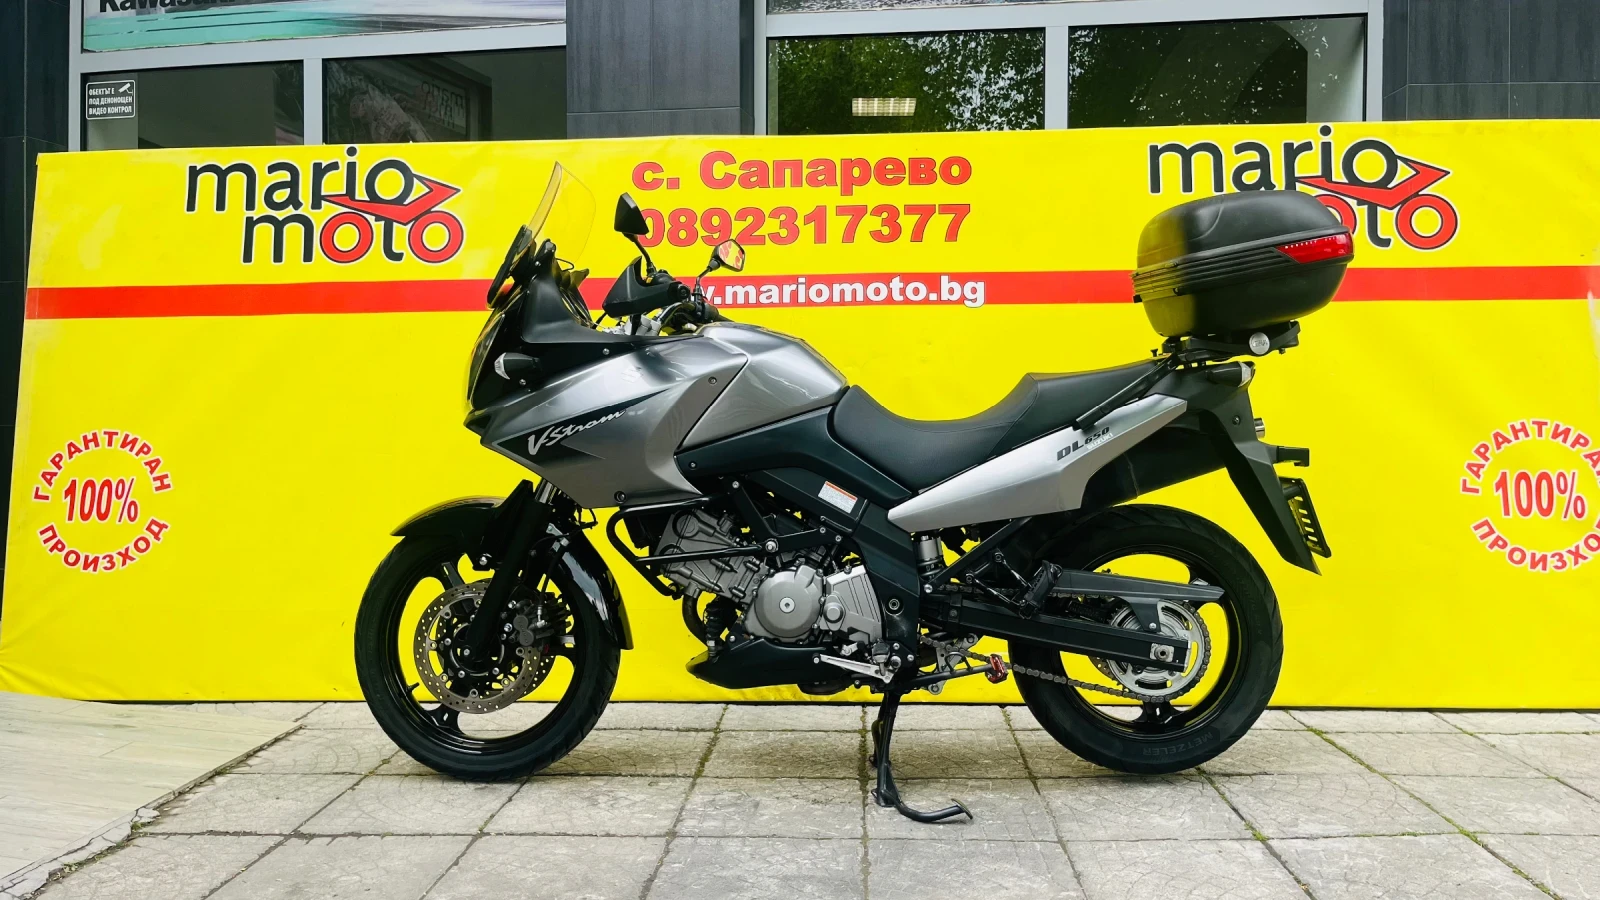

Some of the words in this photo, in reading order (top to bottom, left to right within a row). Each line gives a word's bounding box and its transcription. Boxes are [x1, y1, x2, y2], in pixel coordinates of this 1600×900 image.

[89, 107, 107, 115] ВИДЕО
[108, 106, 132, 114] КОНТРОЛ
[186, 146, 415, 212] mario
[632, 162, 680, 190] с.
[700, 151, 972, 196] Сапарево
[1149, 125, 1398, 193] mario
[242, 211, 464, 263] moto
[637, 204, 971, 247] 0892317377
[33, 430, 172, 501] ГАРАНТИРАН
[1461, 420, 1600, 494] ГАРАНТИРА
[64, 478, 138, 523] 100%
[1494, 471, 1586, 519] 100%
[39, 518, 169, 572] ПРОИЗХОД
[1472, 518, 1600, 572] ПРОИЗХО
[1142, 731, 1214, 756] METZELER
